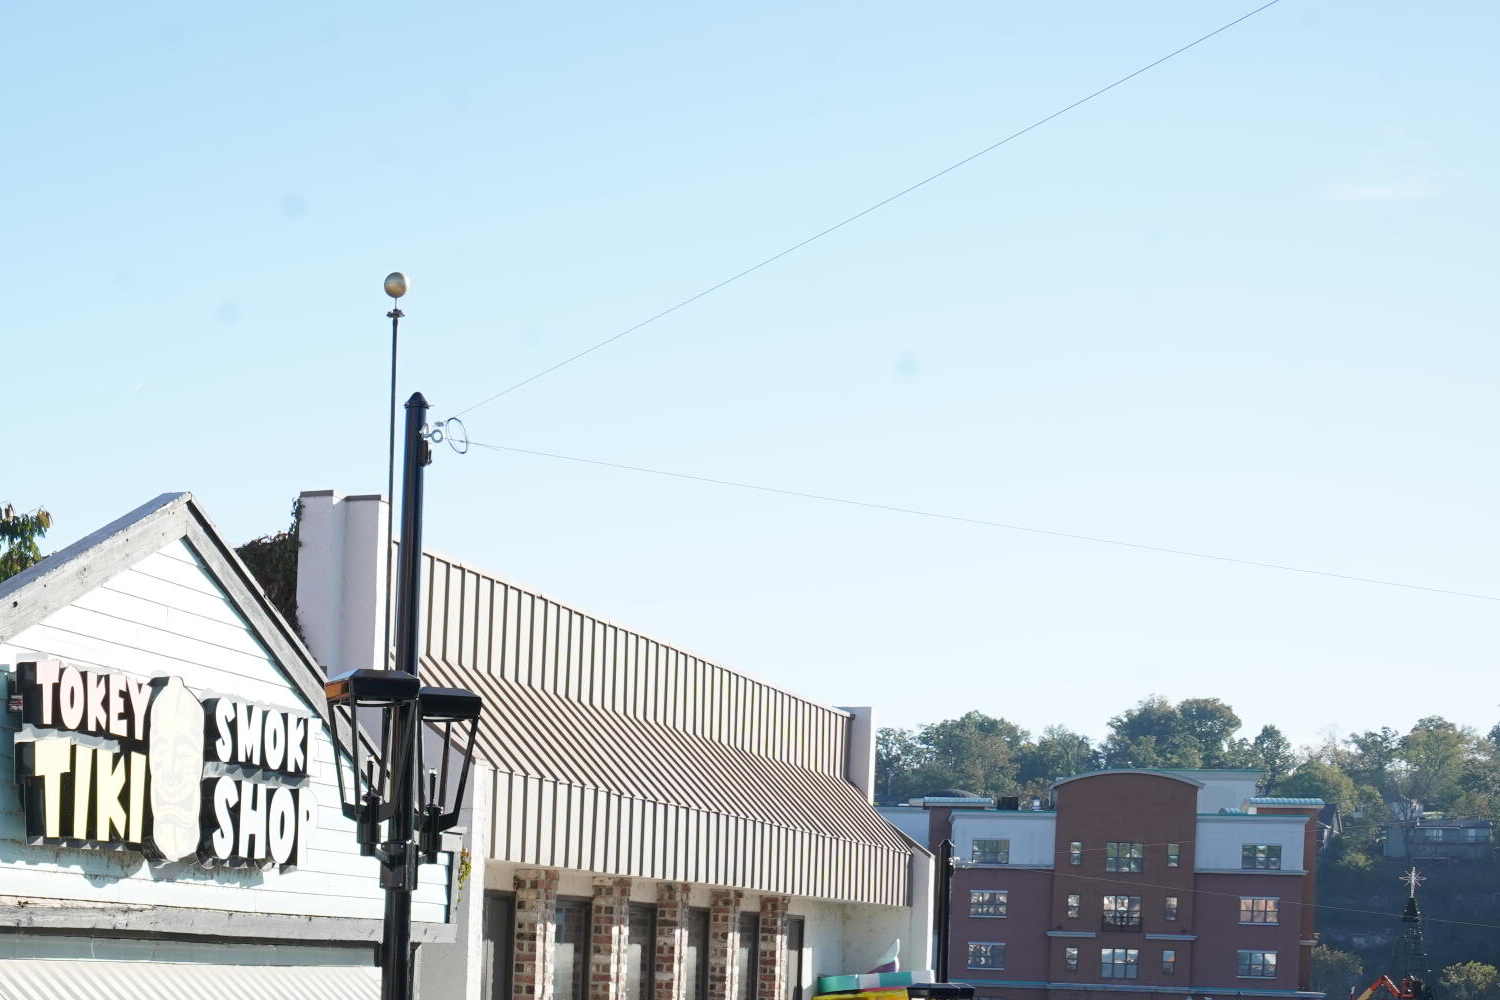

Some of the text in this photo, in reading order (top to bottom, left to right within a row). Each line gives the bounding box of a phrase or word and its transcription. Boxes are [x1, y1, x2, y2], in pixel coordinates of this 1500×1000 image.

[36, 660, 152, 741] TOKEY
[215, 697, 323, 777] SMOKE
[34, 737, 147, 844] TIKI
[212, 775, 319, 868] SHOP
